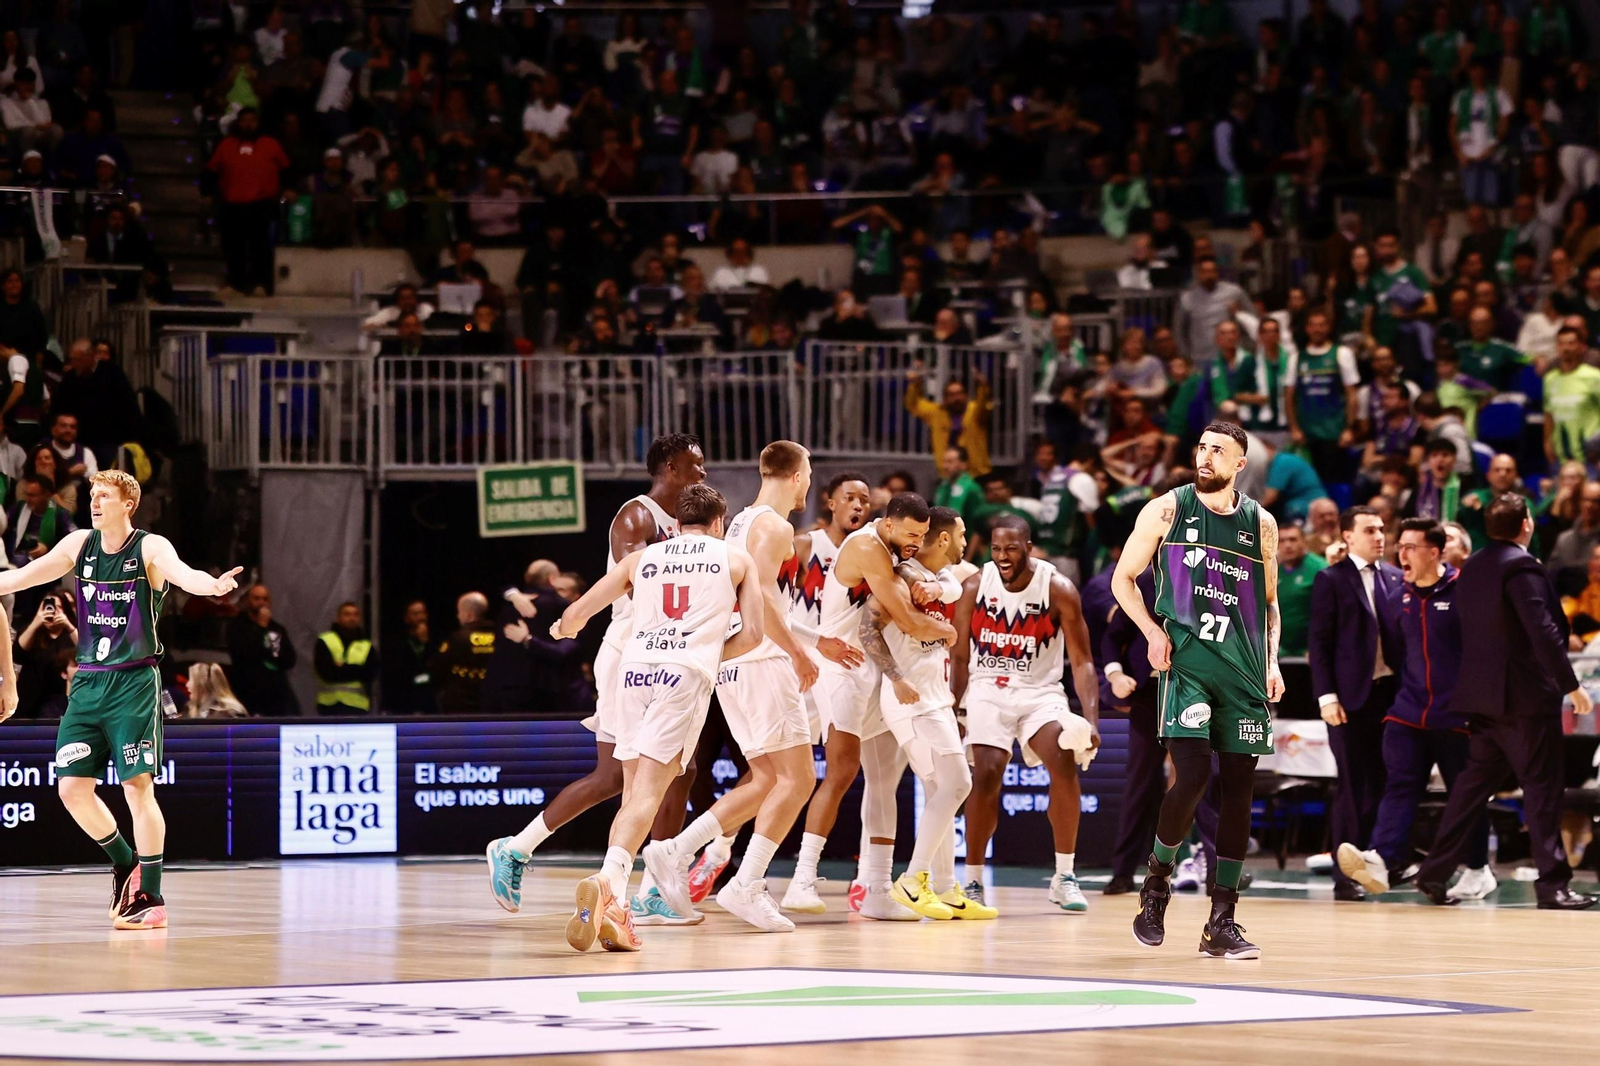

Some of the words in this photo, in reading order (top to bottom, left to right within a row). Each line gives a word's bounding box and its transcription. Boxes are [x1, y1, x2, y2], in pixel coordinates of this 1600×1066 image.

[491, 478, 542, 500] SALIDA
[551, 476, 569, 496] DE
[488, 500, 575, 523] EMERGENCIA
[664, 542, 706, 555] VILLAR
[662, 563, 721, 575] AMUTIO
[1206, 557, 1250, 581] Unicaja
[97, 589, 136, 603] Unicaja
[1194, 583, 1239, 606] málaga
[87, 611, 127, 627] málaga
[1199, 612, 1231, 642] 27
[97, 637, 111, 661] 9
[293, 735, 355, 758] sabor
[1238, 730, 1264, 744] laga
[293, 766, 306, 782] a
[309, 750, 384, 795] má
[414, 763, 435, 784] El
[438, 762, 501, 784] sabor
[1002, 764, 1019, 786] El
[414, 790, 457, 812] que
[460, 788, 500, 806] nos
[503, 787, 545, 806] une
[1002, 794, 1034, 816] que
[0, 802, 36, 828] ga
[293, 789, 384, 845] laga
